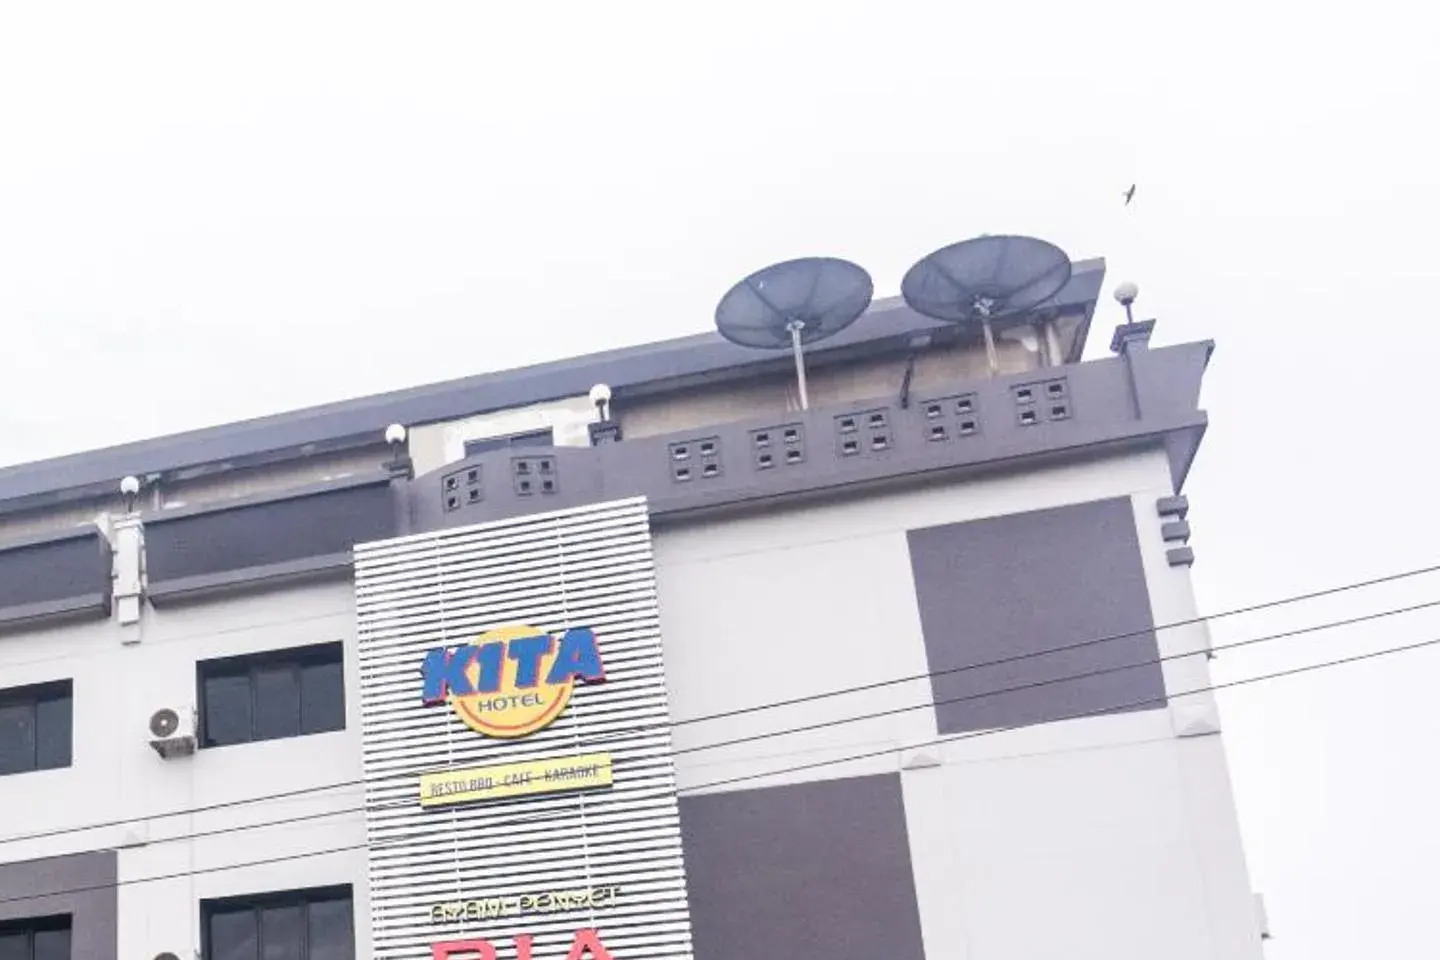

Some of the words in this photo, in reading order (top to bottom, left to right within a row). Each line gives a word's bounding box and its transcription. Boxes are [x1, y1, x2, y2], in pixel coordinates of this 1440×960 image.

[420, 626, 606, 707] KITA
[478, 692, 546, 713] HOTEL
[503, 771, 533, 786] CAFE
[544, 764, 600, 782] KARAOKE
